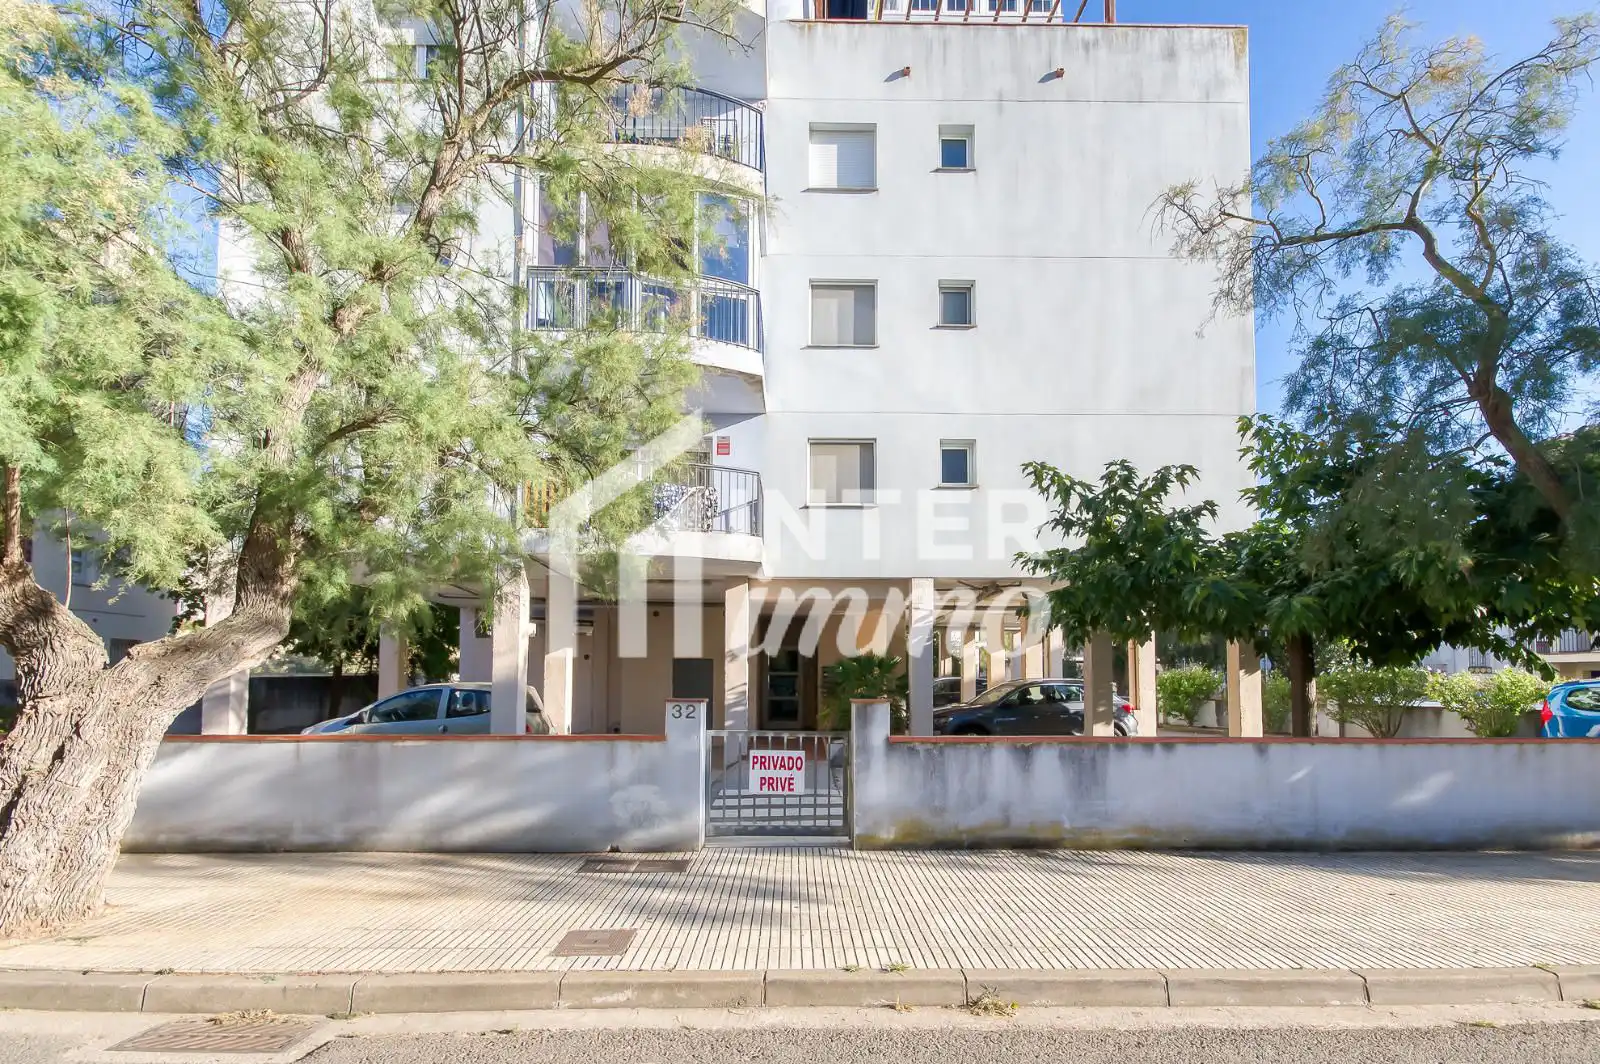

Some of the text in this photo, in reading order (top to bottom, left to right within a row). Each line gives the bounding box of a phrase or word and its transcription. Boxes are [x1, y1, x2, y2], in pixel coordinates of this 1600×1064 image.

[671, 704, 696, 719] 32
[751, 755, 804, 771] PRIVADO
[759, 773, 795, 792] PRIVÉ
